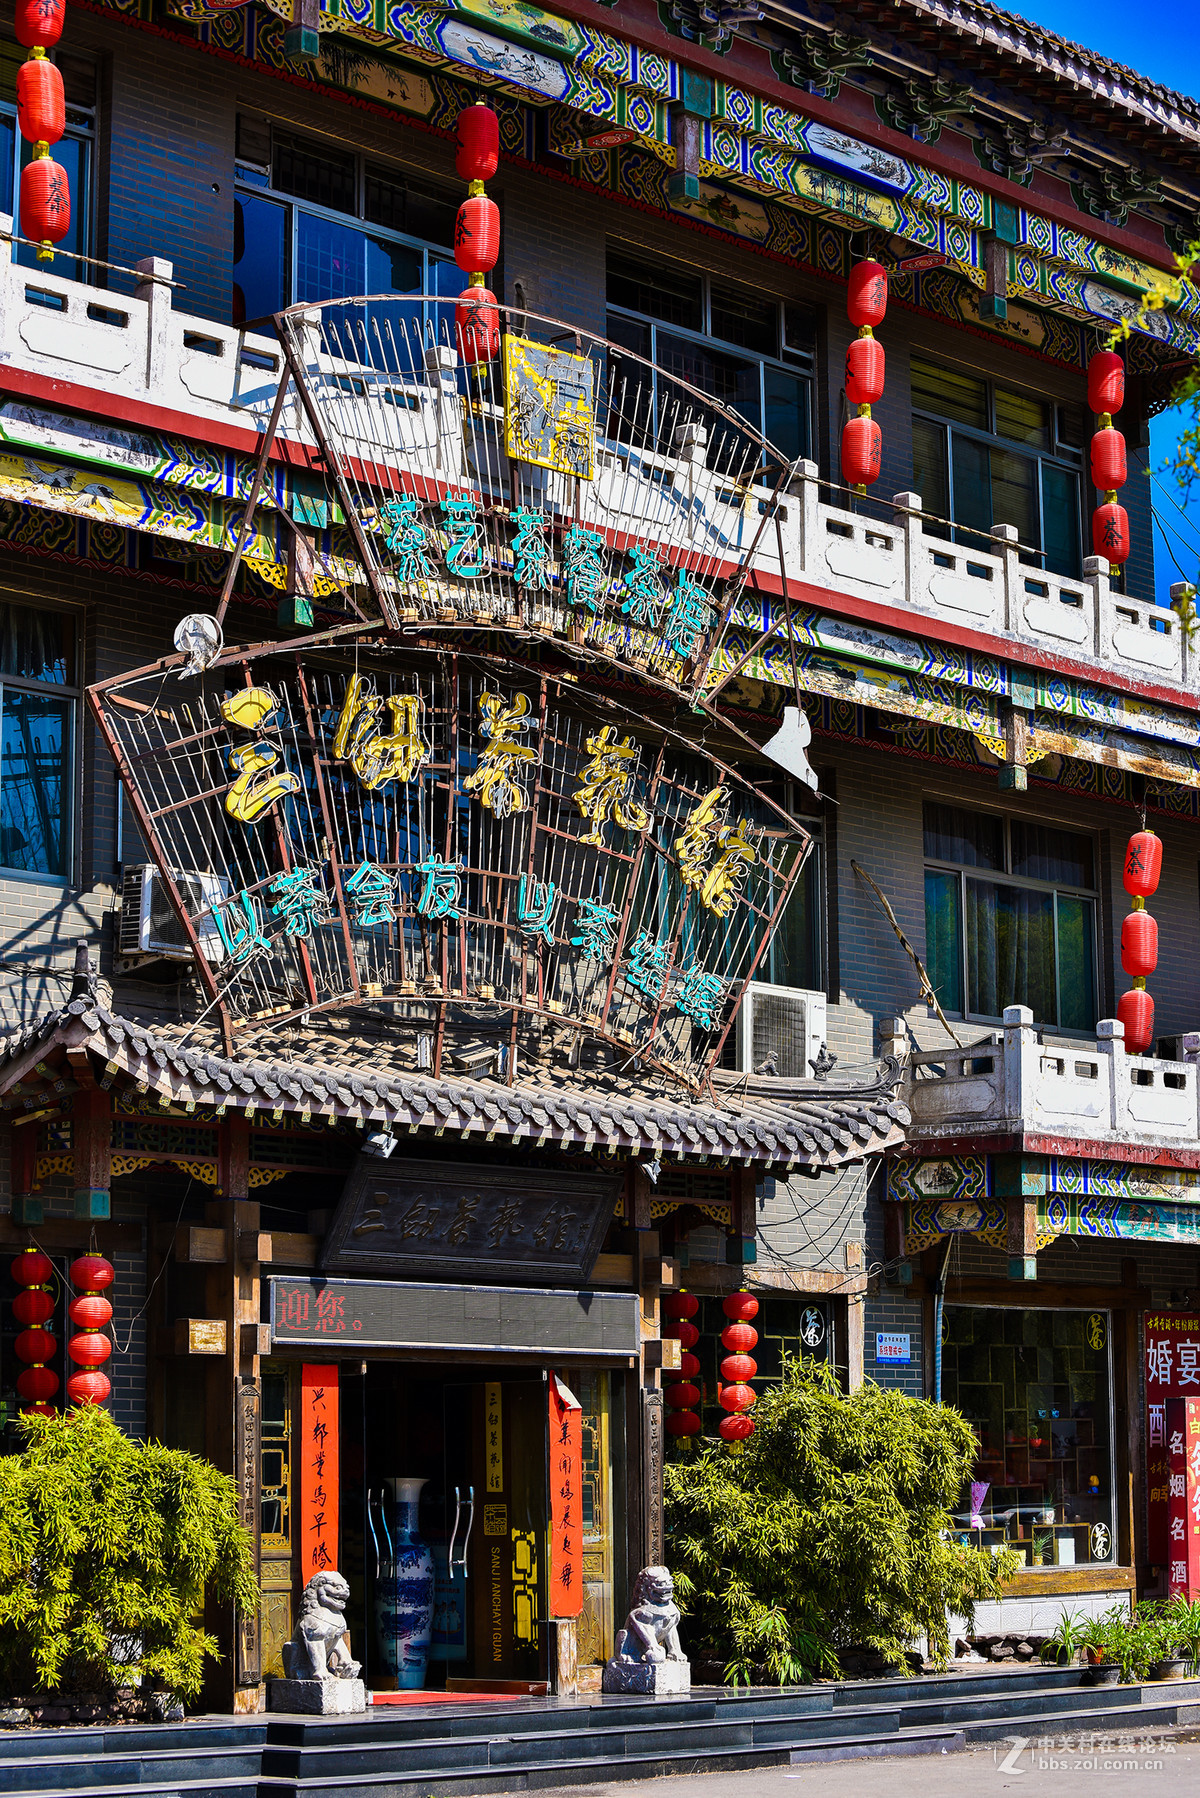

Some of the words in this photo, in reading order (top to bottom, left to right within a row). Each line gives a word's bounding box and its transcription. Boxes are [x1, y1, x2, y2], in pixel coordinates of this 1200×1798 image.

[1103, 516, 1124, 548] 茶
[1125, 845, 1145, 876] 茶
[1147, 1338, 1200, 1386] 婚宴
[1168, 1430, 1187, 1584] 名烟名酒
[491, 1546, 502, 1662] SANJIANCHAYIGUAN
